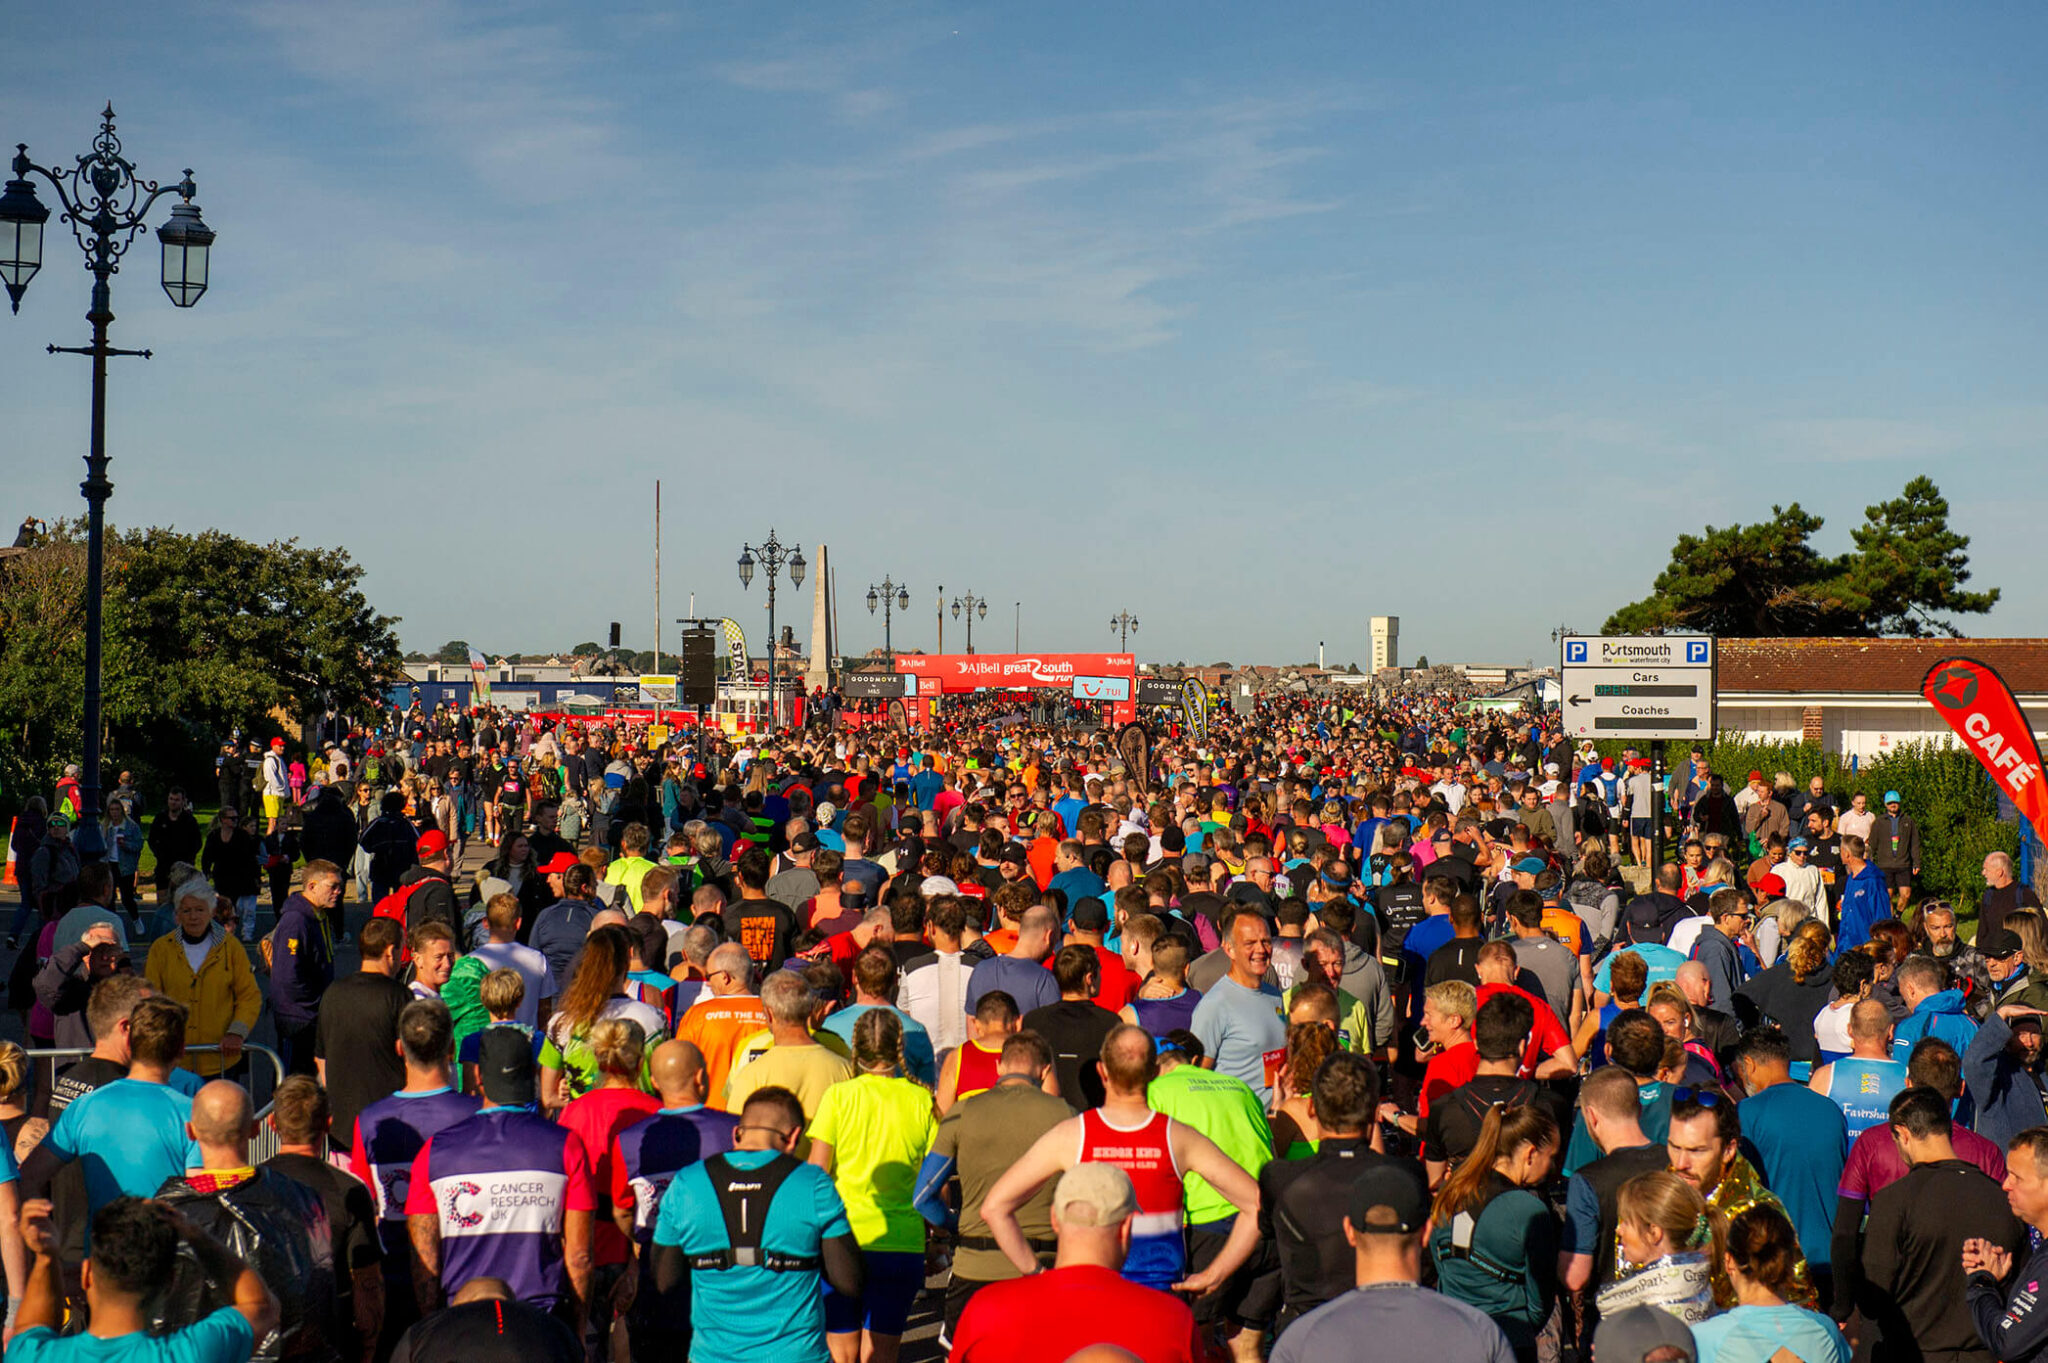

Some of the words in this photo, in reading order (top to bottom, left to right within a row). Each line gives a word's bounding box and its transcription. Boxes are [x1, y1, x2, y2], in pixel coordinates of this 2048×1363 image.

[1571, 643, 1585, 661] P
[1602, 643, 1671, 656] Portsmouth
[1691, 643, 1705, 661] P
[1629, 656, 1658, 664] waterfront
[1660, 656, 1671, 665] city
[1003, 662, 1032, 676] great
[1042, 661, 1073, 673] south
[1632, 672, 1659, 682] Cars
[919, 681, 935, 690] Bell
[1595, 684, 1629, 696] OPEN
[1105, 688, 1121, 697] TUI
[1621, 705, 1670, 715] Coaches
[1965, 712, 2040, 793] CAFÉ
[740, 916, 776, 929] SWIM
[705, 1010, 732, 1020] OVER
[733, 1010, 754, 1019] THE
[1092, 1147, 1134, 1159] HEDGE
[1135, 1147, 1162, 1159] END
[1136, 1160, 1158, 1169] CLUB
[489, 1182, 545, 1195] CANCER
[490, 1195, 556, 1208] RESEARCH
[490, 1208, 509, 1221] UK
